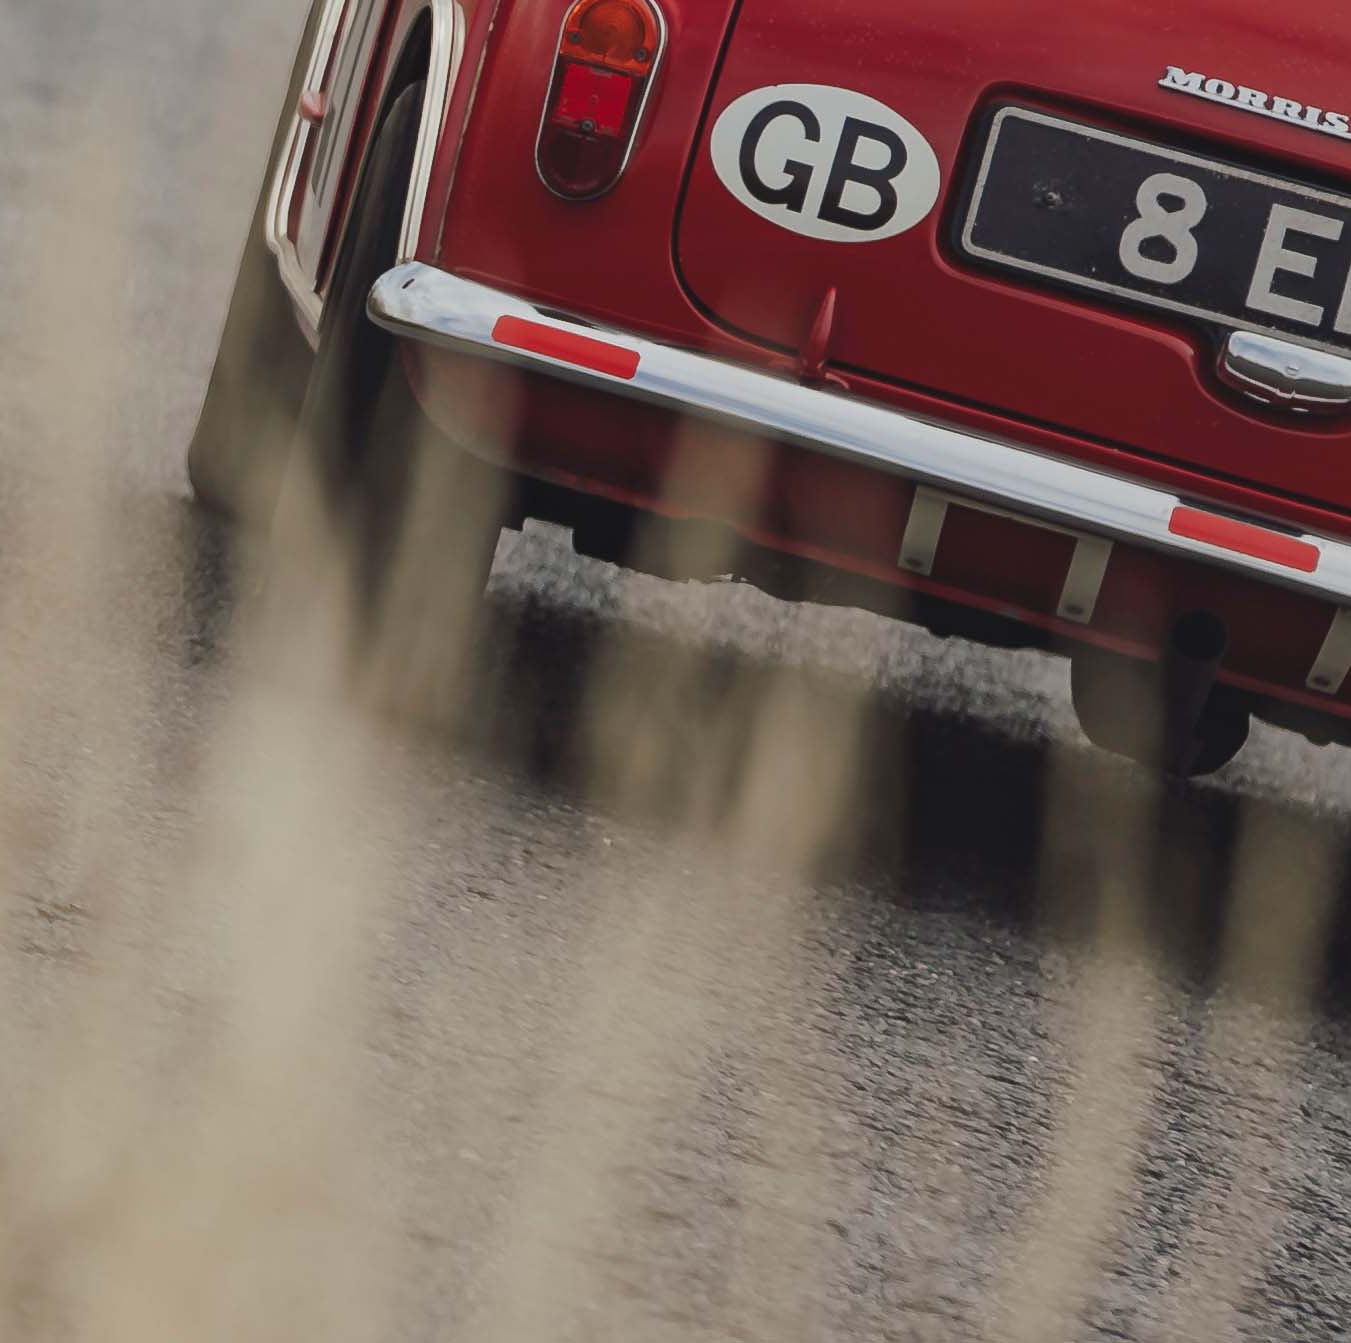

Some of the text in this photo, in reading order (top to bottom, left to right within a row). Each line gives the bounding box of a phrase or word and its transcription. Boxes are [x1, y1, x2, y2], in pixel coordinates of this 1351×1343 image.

[1159, 65, 1350, 133] MORRIS
[738, 99, 908, 232] GB
[1118, 172, 1208, 285] 8
